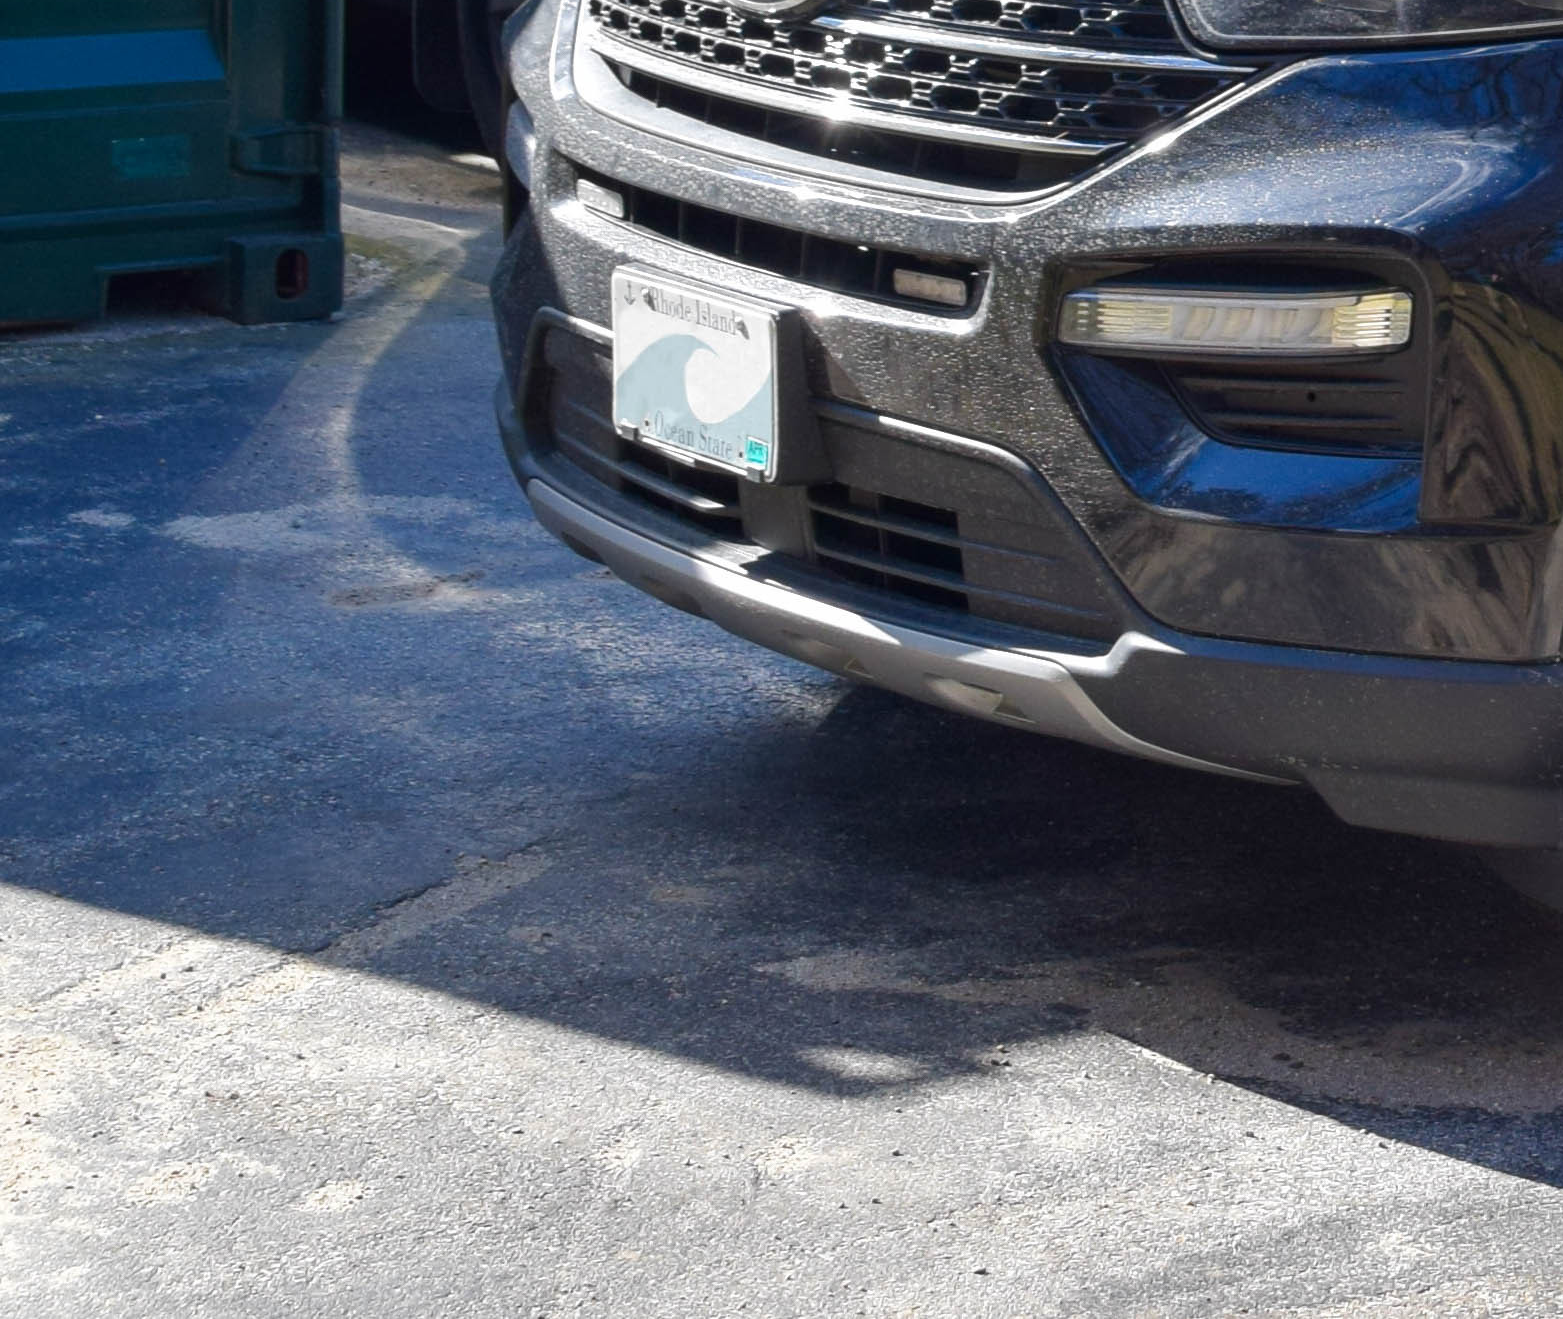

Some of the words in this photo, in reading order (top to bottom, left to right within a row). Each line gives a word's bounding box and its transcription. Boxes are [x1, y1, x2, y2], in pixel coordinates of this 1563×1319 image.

[648, 285, 692, 322] Rhode
[695, 299, 738, 336] Island
[654, 409, 695, 448] Ocean
[699, 424, 734, 459] State
